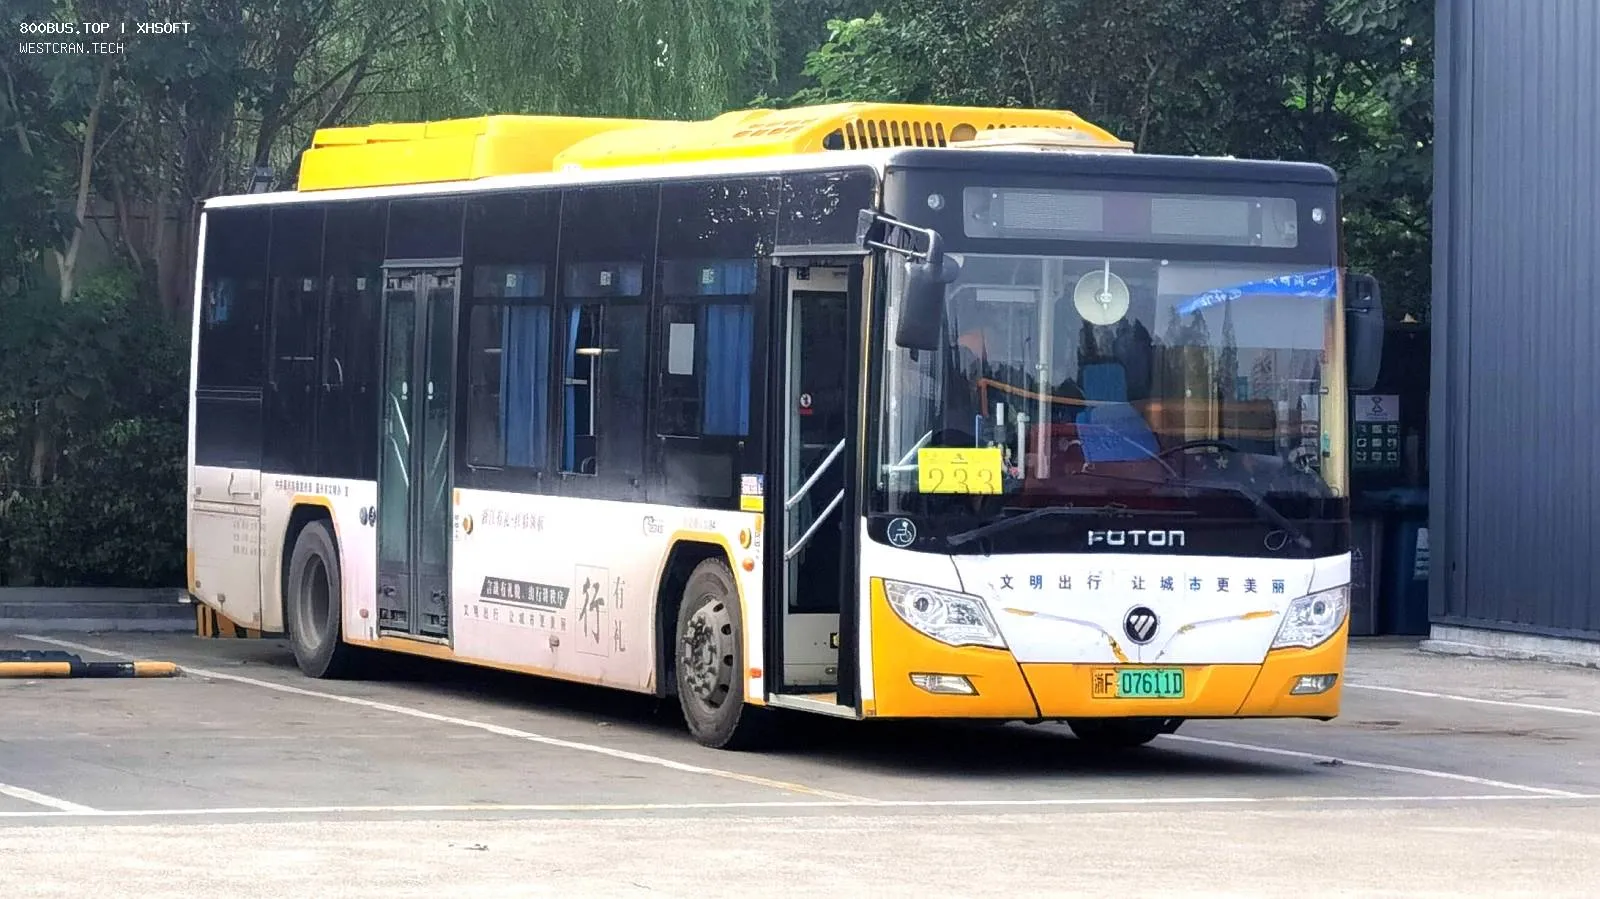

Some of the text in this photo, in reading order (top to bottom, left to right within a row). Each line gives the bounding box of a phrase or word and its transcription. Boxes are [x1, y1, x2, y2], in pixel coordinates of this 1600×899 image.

[928, 468, 995, 494] 233
[1088, 530, 1185, 546] FOTON
[1000, 574, 1285, 594] 文明出行 让城市更美丽
[578, 576, 605, 645] 行
[613, 576, 626, 652] 有礼
[1094, 673, 1183, 694] 浙F 07611D
